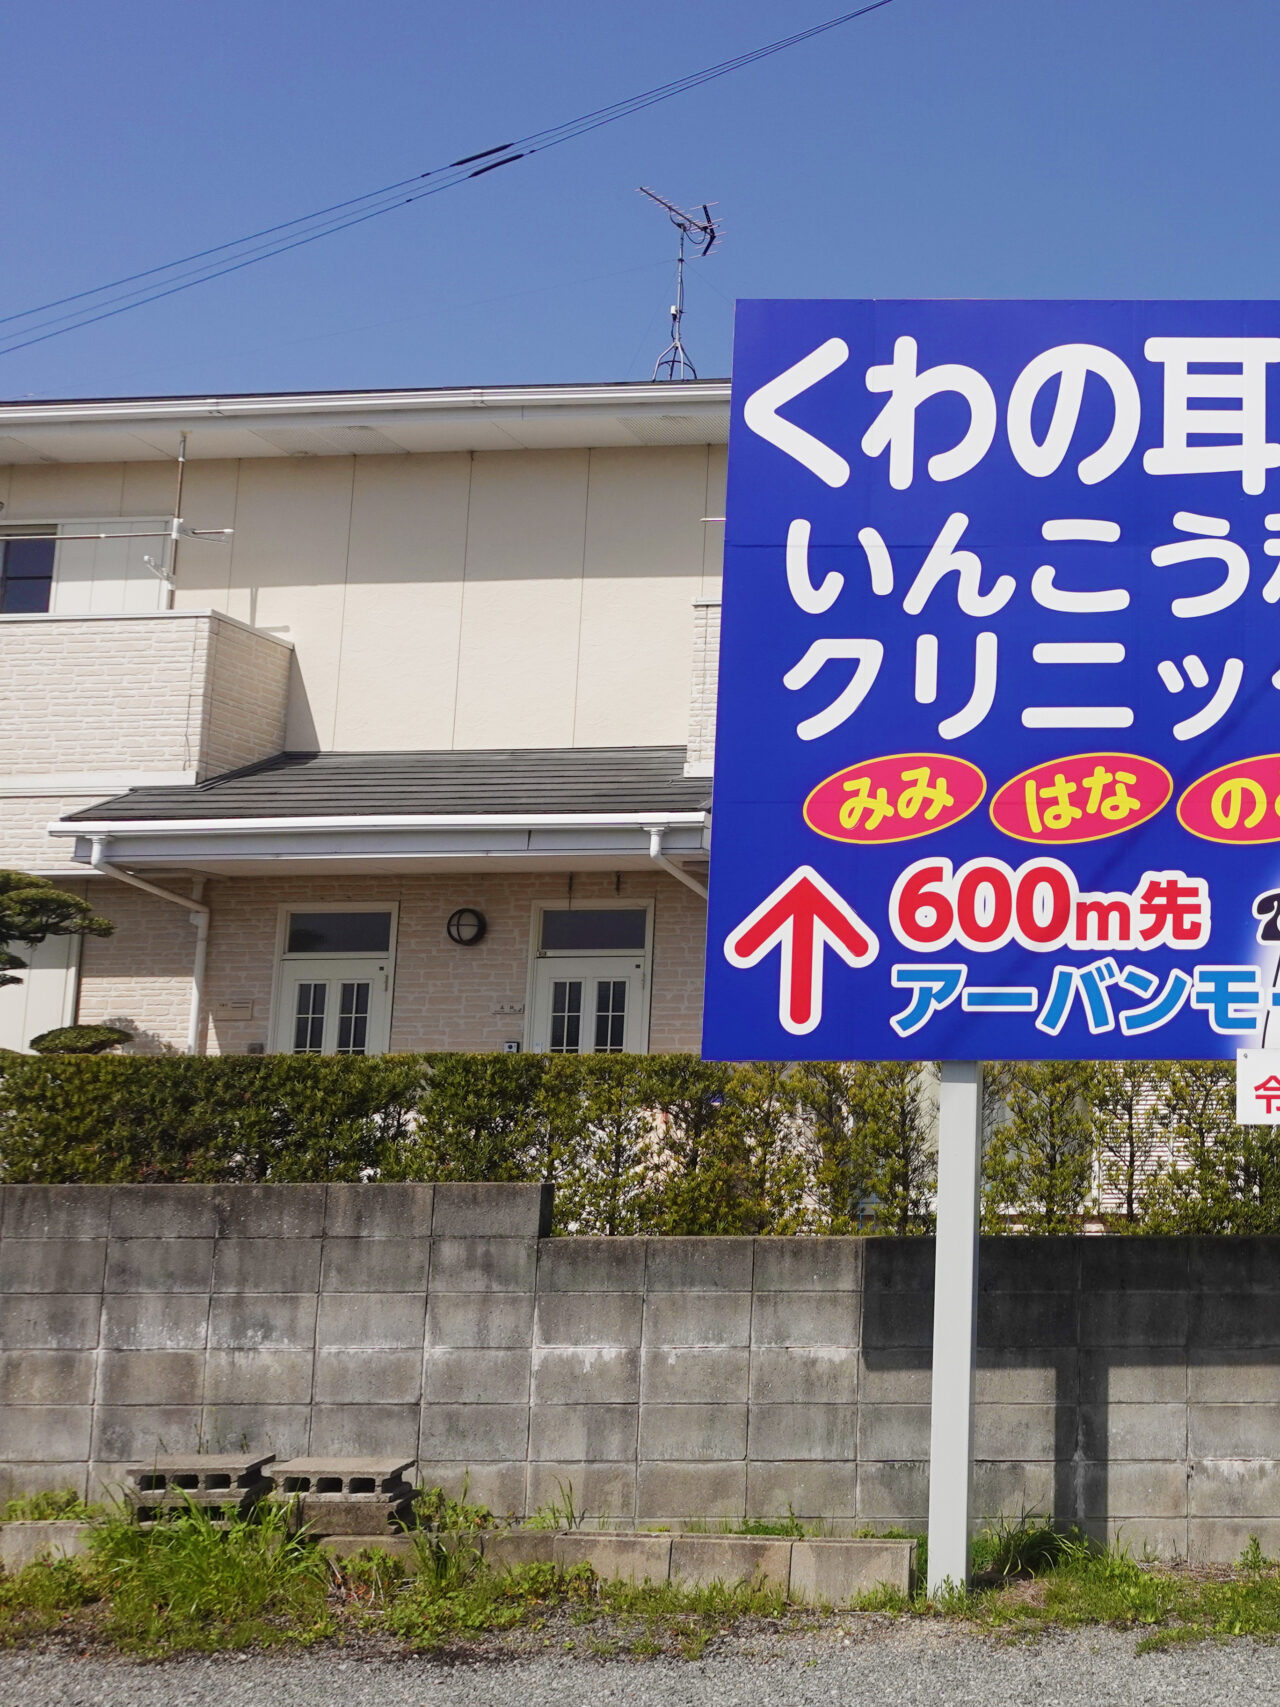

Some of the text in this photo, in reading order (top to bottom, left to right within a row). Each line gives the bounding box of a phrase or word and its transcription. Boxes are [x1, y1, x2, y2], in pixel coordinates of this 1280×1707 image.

[838, 766, 955, 831] みみ
[1024, 765, 1142, 834] はな
[898, 866, 1202, 943] 600m先
